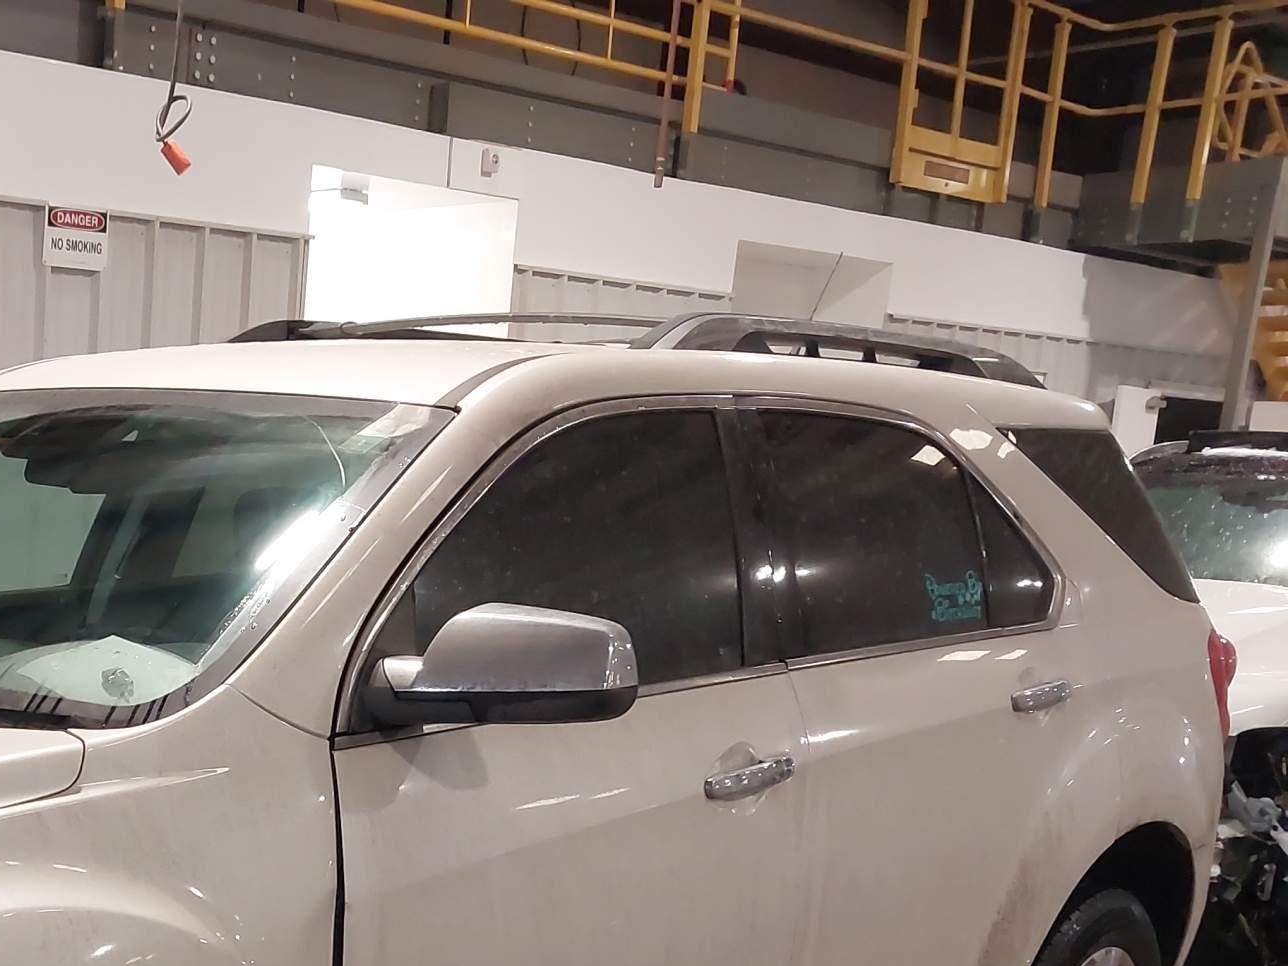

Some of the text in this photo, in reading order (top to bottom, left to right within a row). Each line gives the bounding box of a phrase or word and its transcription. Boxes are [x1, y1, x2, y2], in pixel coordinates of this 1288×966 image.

[57, 211, 99, 228] DANGER
[50, 237, 103, 255] NO SMOKING
